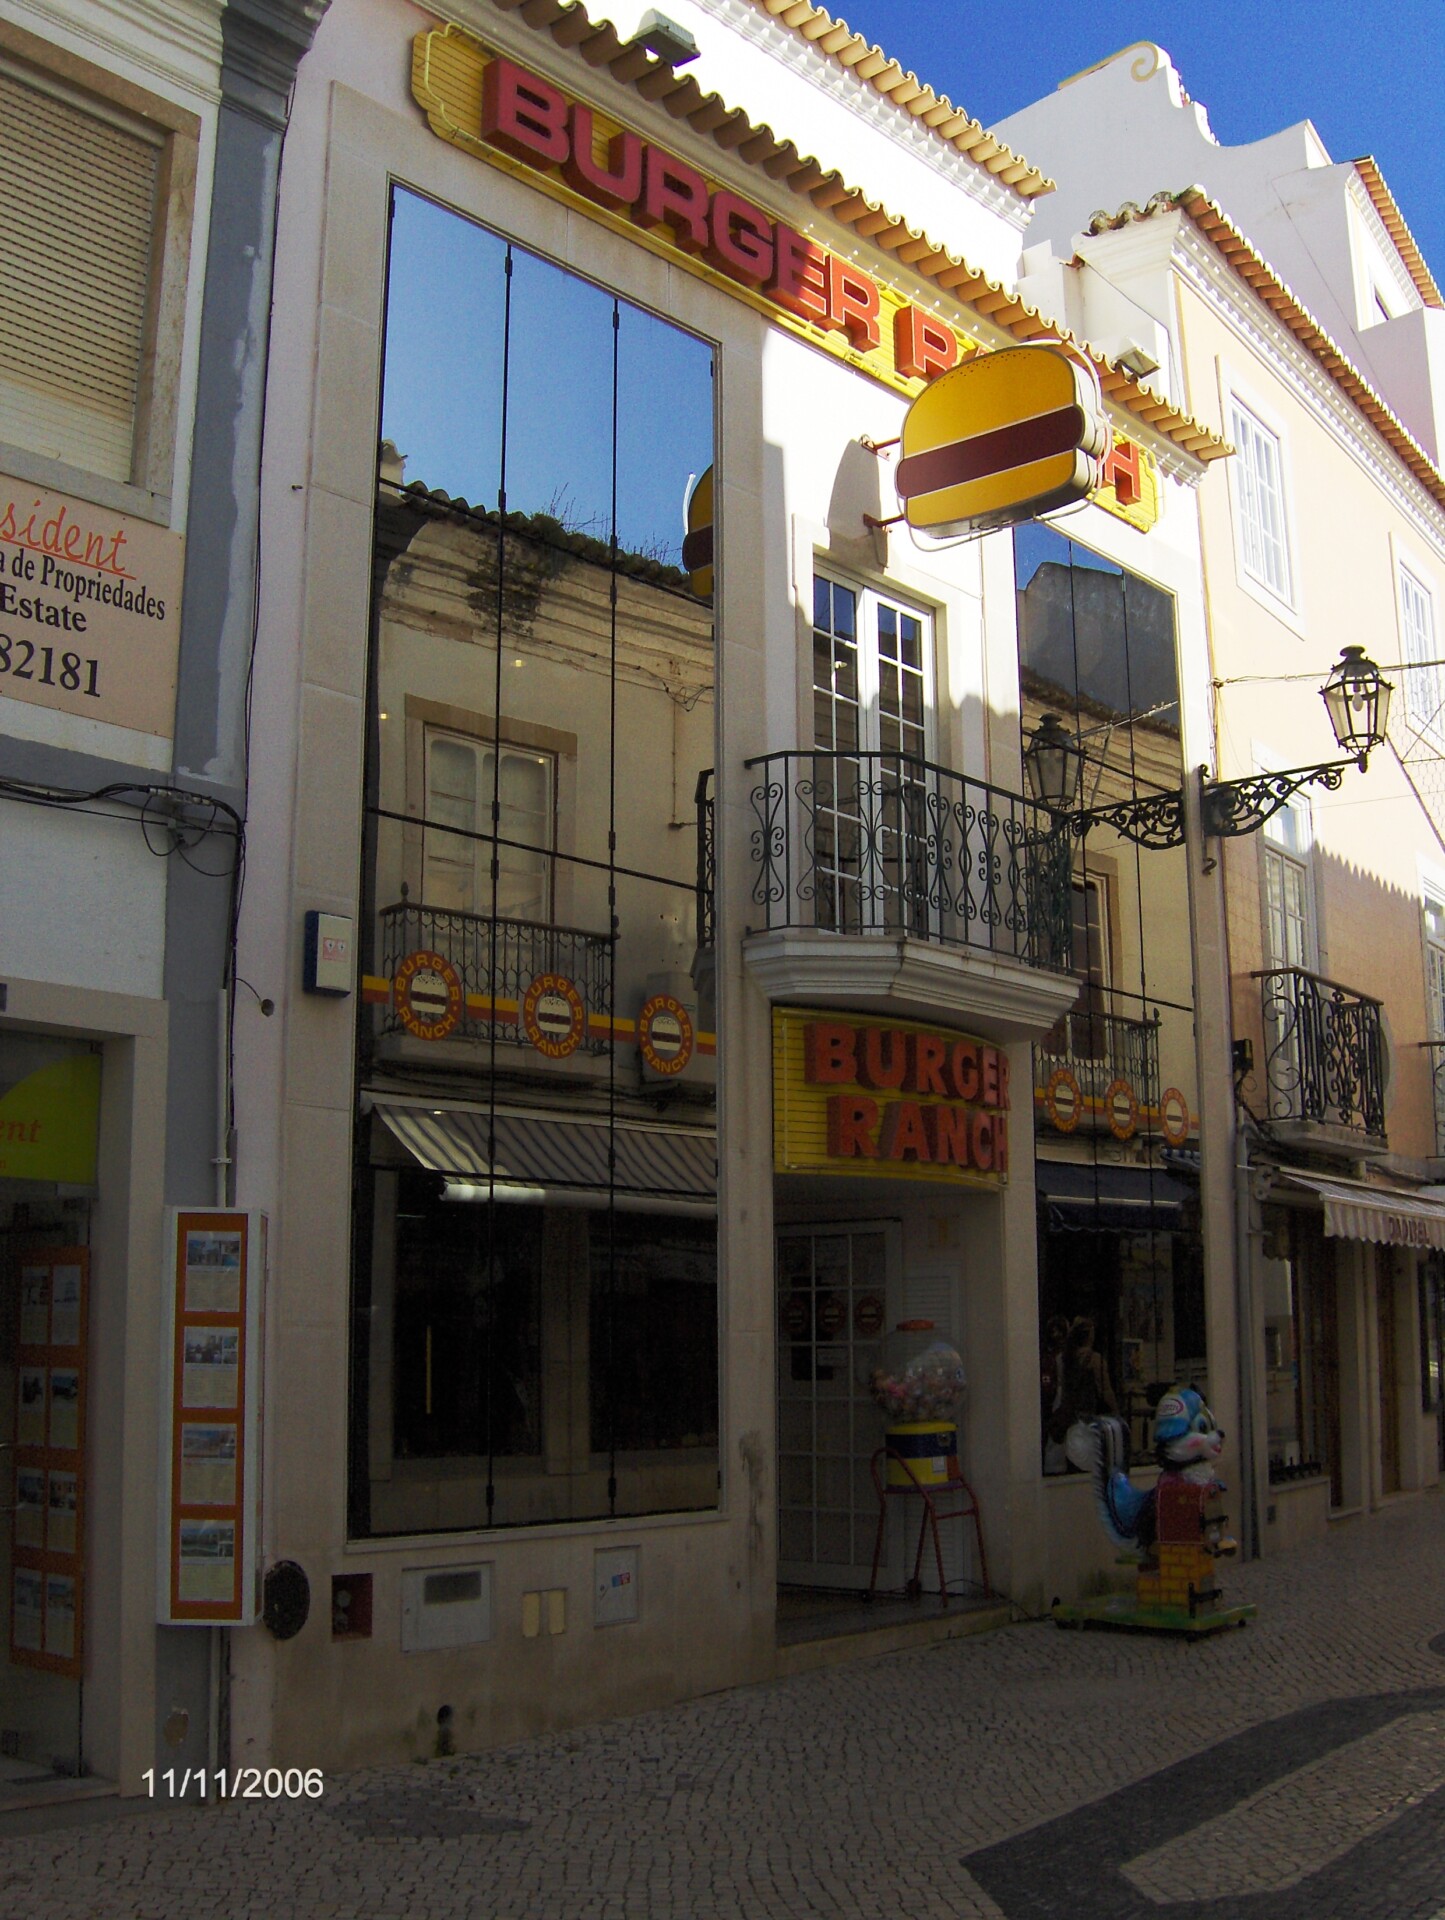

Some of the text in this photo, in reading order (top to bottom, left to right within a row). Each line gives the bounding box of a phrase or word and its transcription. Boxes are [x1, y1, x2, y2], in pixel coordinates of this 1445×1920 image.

[482, 56, 880, 352] BURGER
[0, 582, 87, 632] Estate
[12, 548, 35, 580] de
[41, 554, 165, 621] Propriedades
[396, 953, 459, 1001] BURGER
[525, 976, 583, 1020] BURGER
[399, 1006, 456, 1039] RANCH
[529, 1026, 579, 1056] RANCH
[640, 997, 691, 1038] BURGER
[643, 1045, 689, 1073] RANCH
[803, 1020, 1011, 1111] BURGER
[826, 1095, 1008, 1172] RANCH
